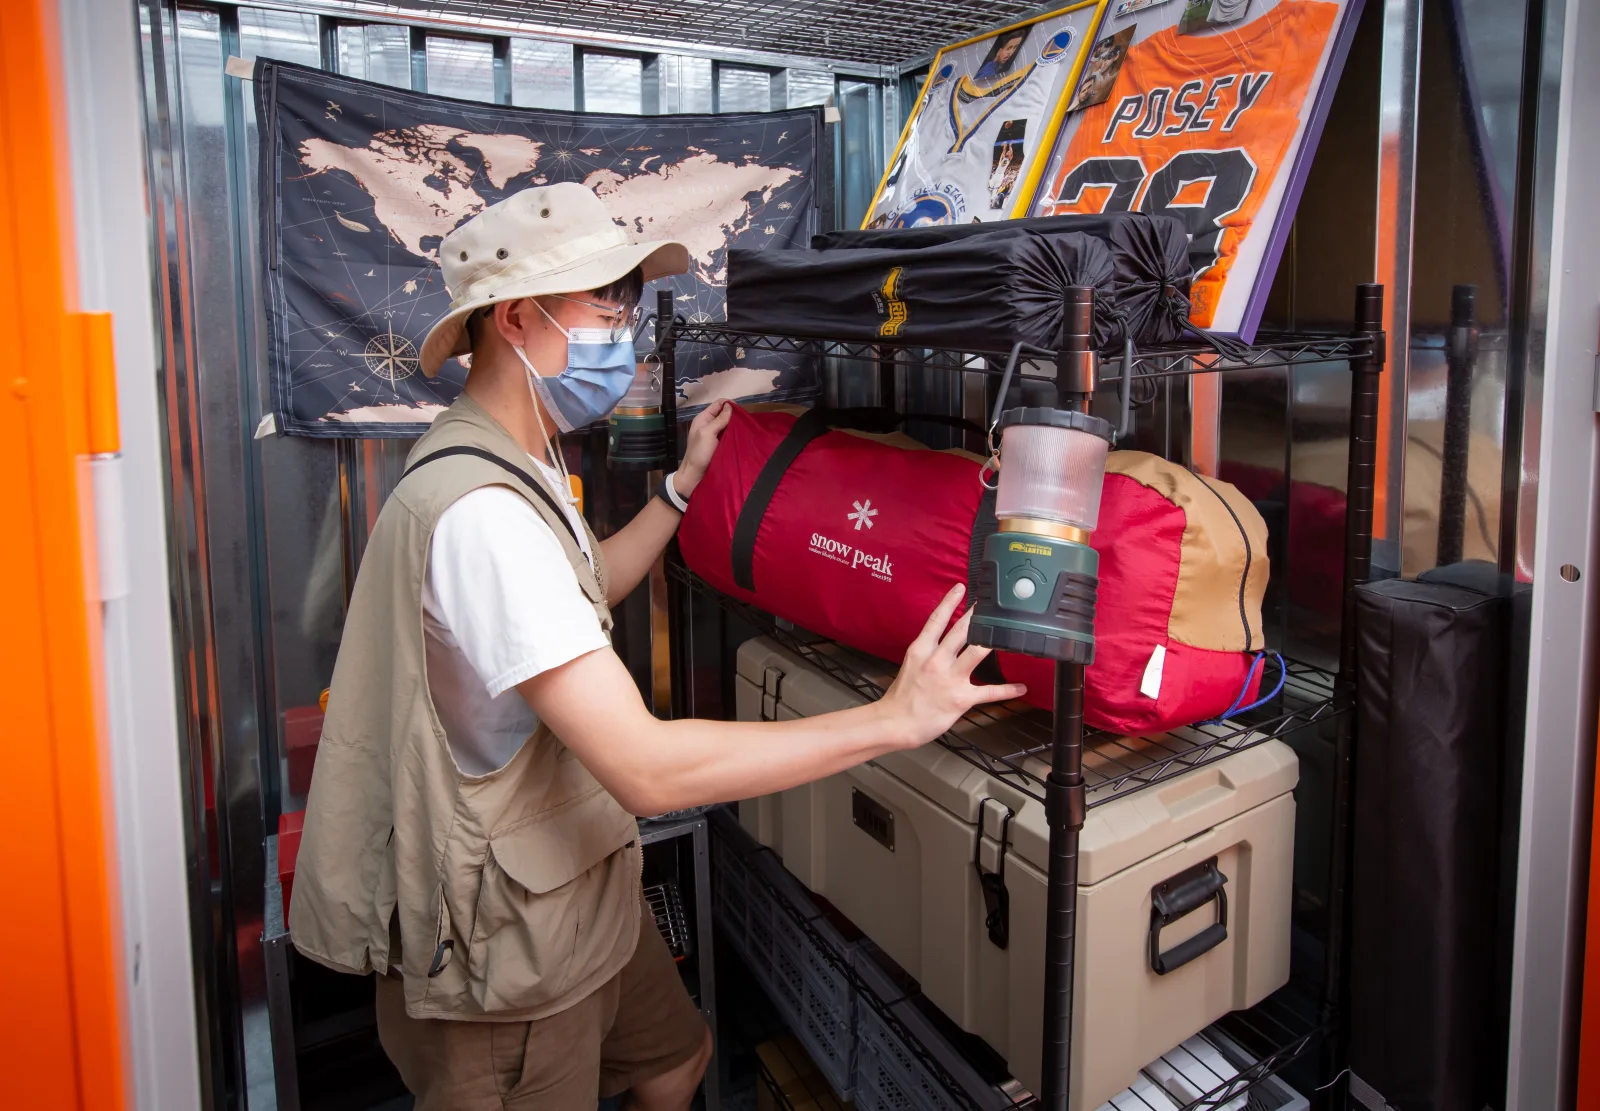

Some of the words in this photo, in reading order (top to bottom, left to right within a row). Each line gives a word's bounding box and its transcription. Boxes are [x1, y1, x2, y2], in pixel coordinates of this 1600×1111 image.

[1101, 71, 1274, 144] POSEY
[943, 184, 966, 217] STATE
[383, 310, 396, 320] N
[336, 348, 349, 357] W
[392, 393, 400, 401] S
[810, 532, 852, 558] snow
[851, 553, 893, 577] peak
[1025, 547, 1052, 557] LANTERN
